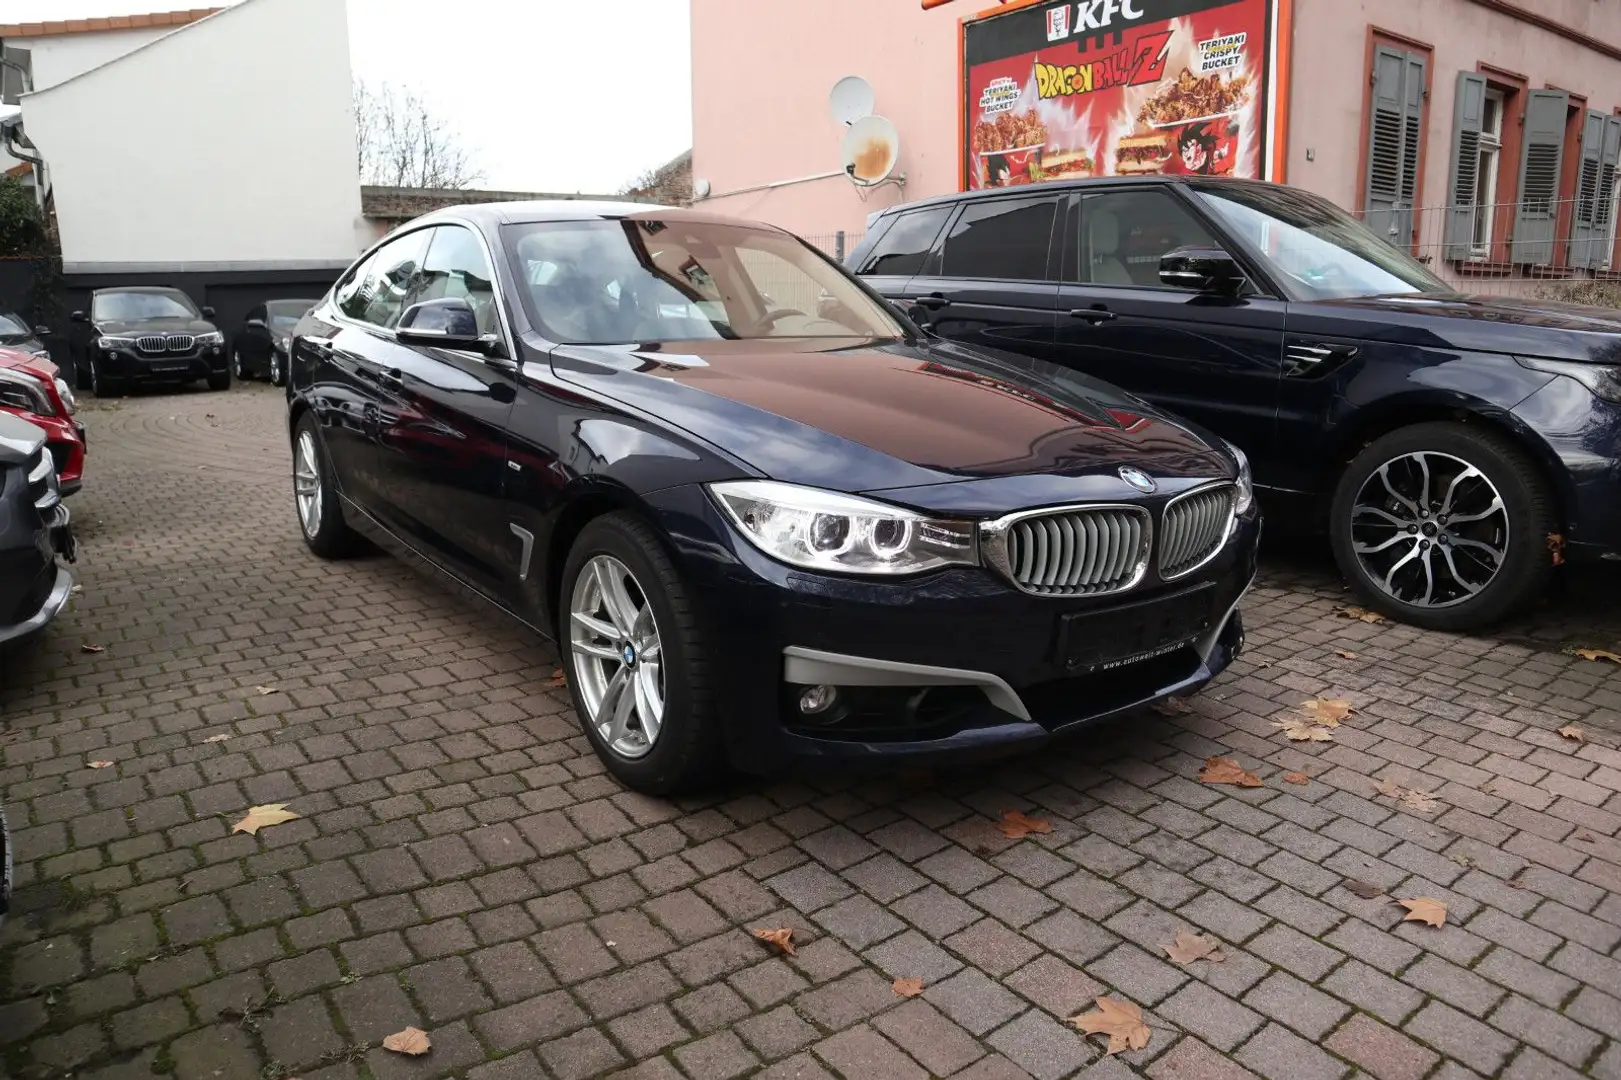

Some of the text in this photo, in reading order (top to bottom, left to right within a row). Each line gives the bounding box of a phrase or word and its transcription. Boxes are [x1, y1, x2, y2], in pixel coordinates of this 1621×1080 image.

[1073, 0, 1144, 33] KFC
[1200, 35, 1245, 51] TERIYAKI
[1204, 46, 1239, 60] CRISPY
[1202, 56, 1240, 70] BUCKET
[987, 101, 1013, 112] BUCKET
